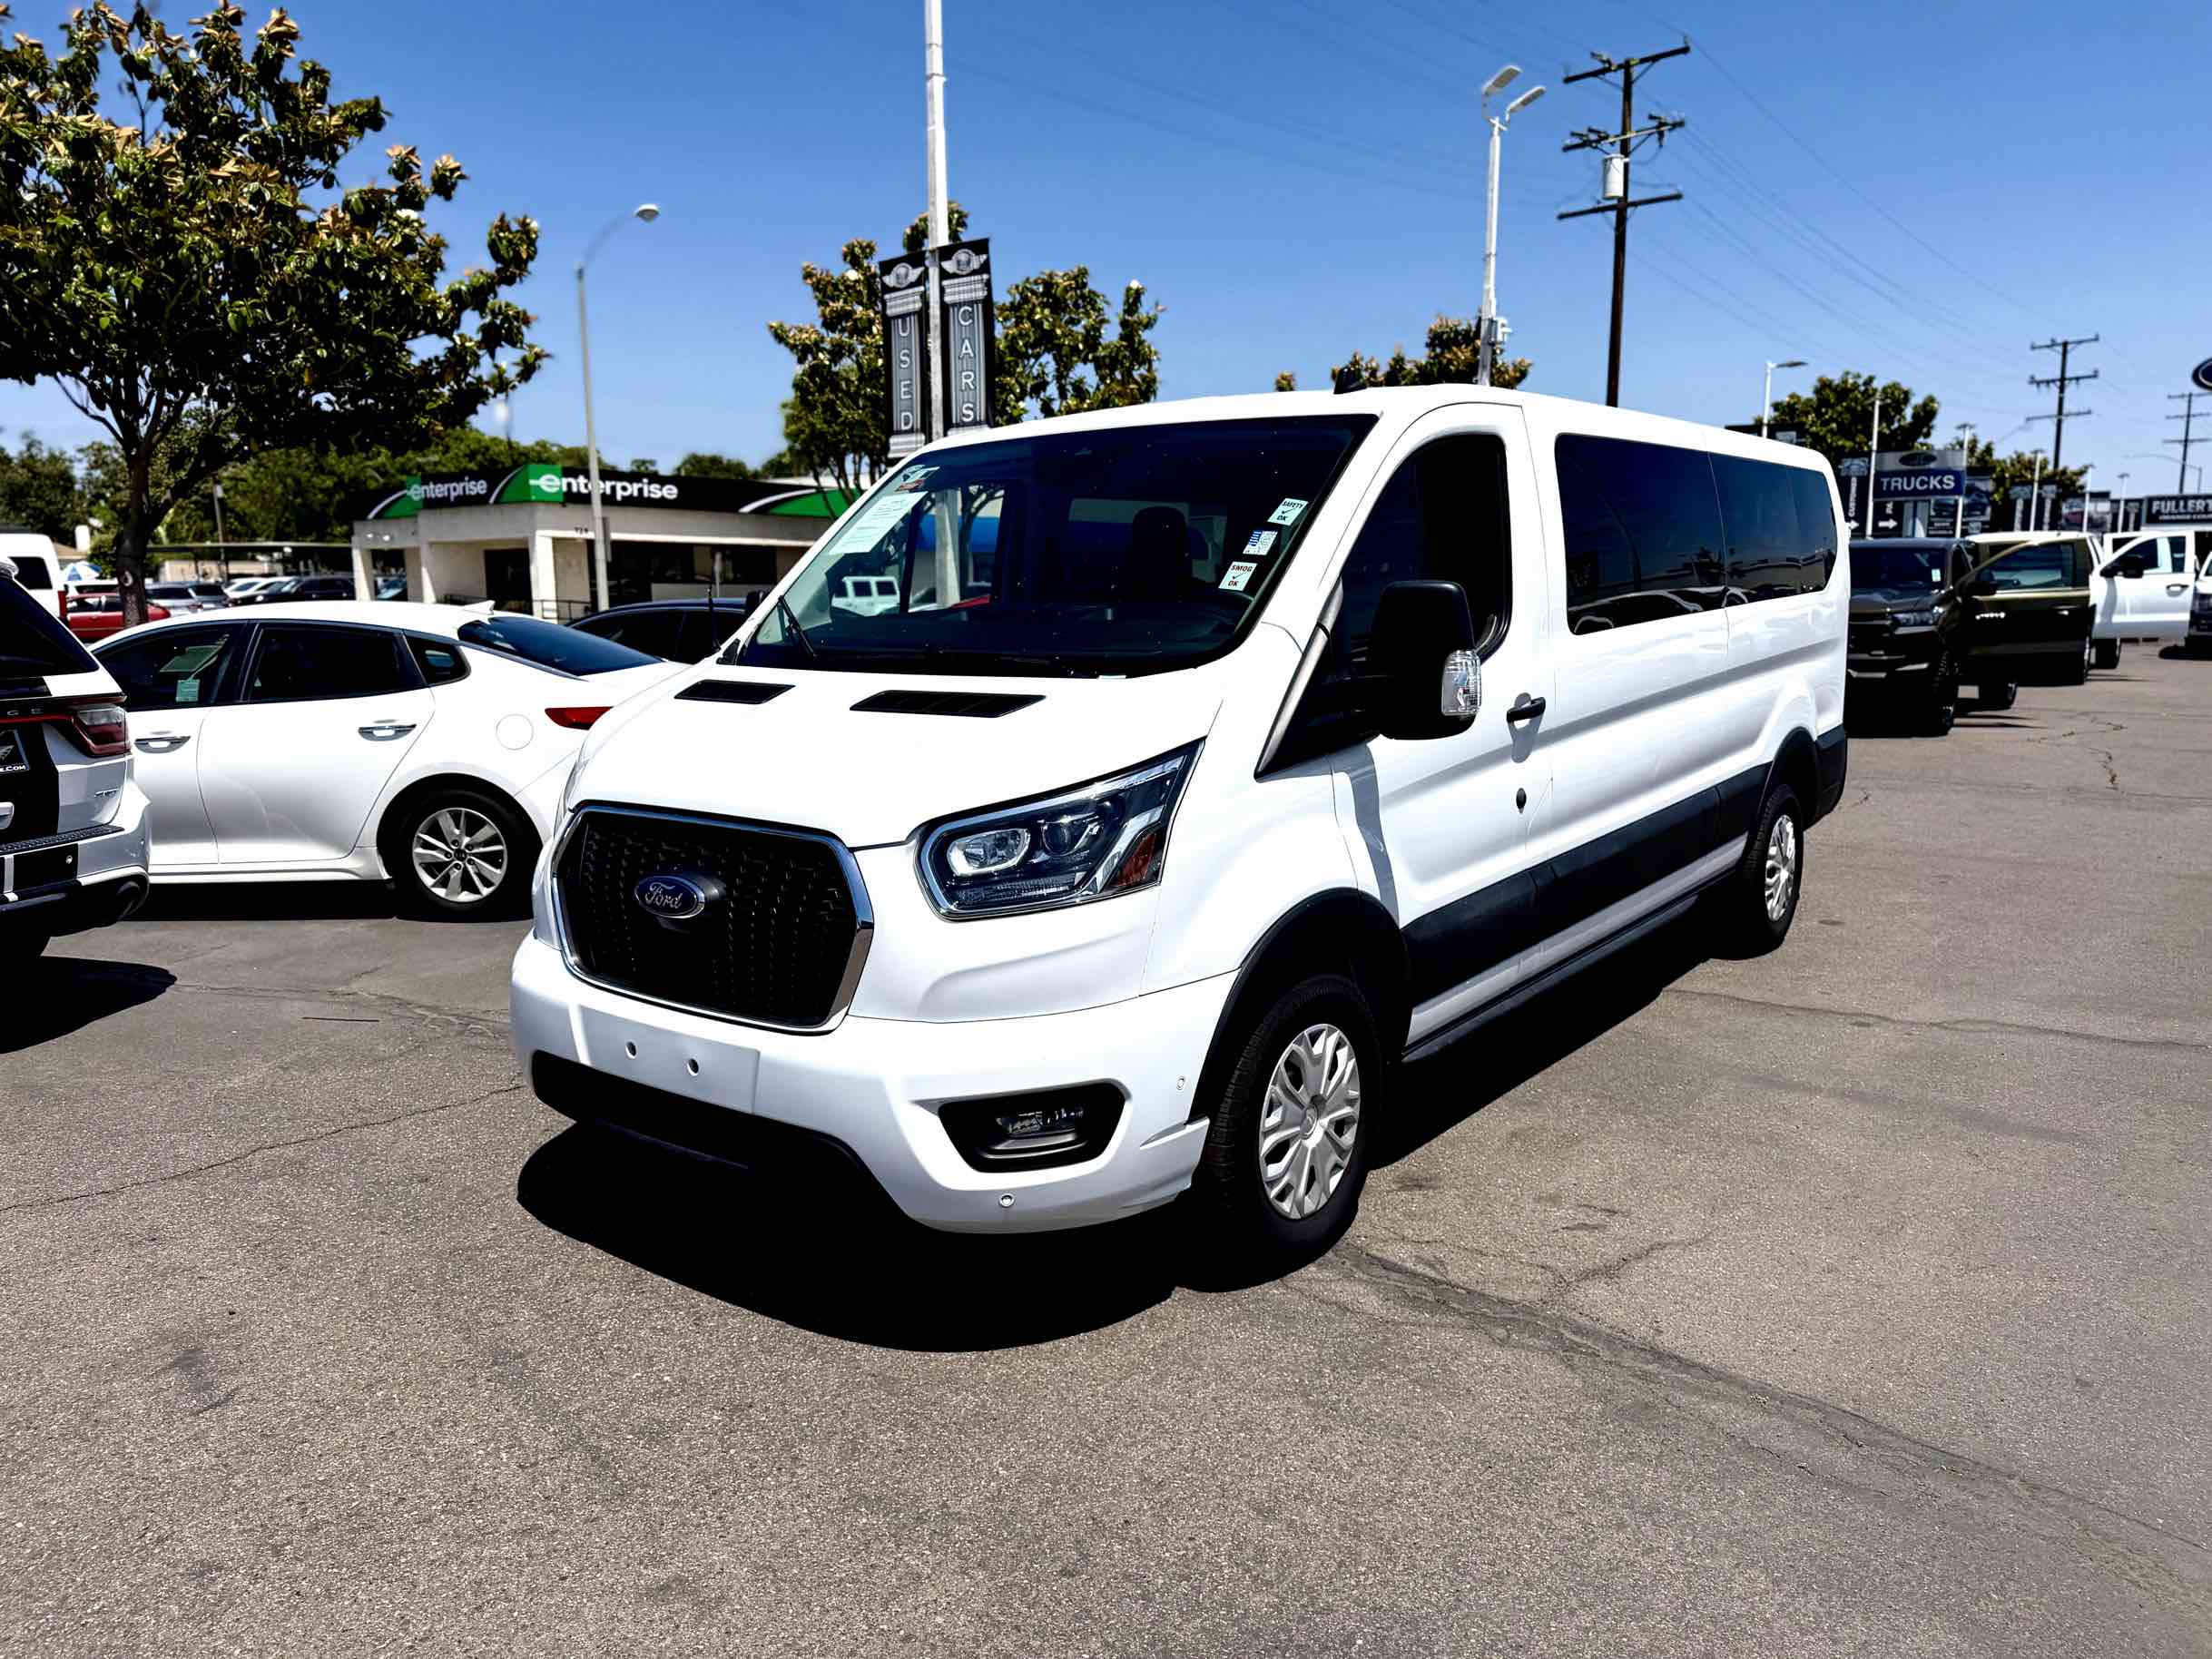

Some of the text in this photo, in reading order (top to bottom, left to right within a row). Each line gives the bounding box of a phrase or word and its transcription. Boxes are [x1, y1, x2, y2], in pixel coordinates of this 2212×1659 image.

[898, 317, 913, 430] USED
[958, 305, 975, 422] CARS
[408, 475, 487, 502] enterprise
[1880, 475, 1955, 492] TRUCKS
[1282, 500, 1303, 509] SAFETY
[645, 882, 683, 908] Ford
